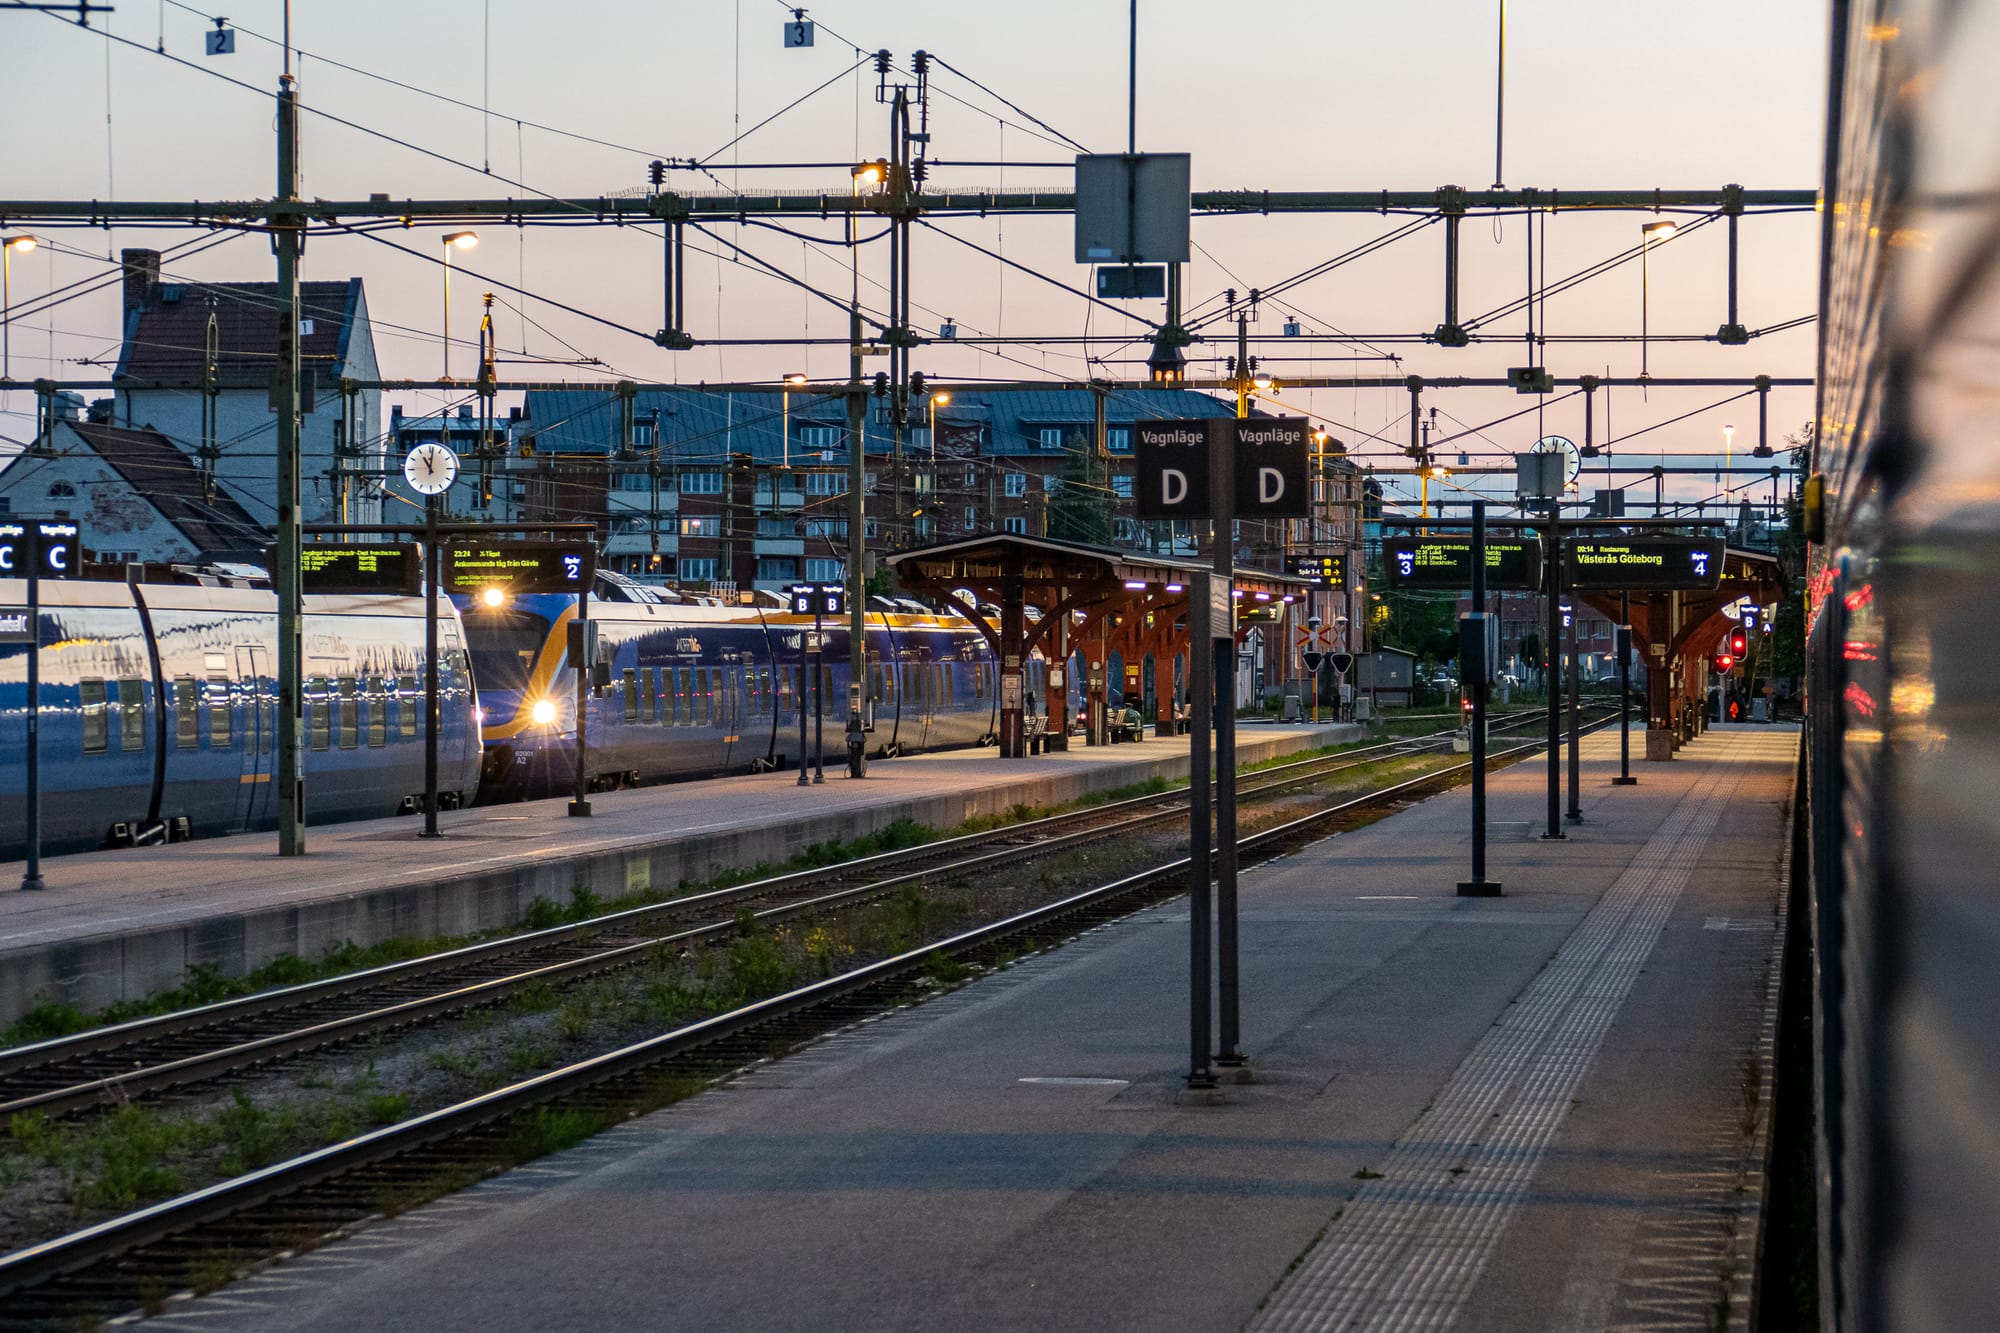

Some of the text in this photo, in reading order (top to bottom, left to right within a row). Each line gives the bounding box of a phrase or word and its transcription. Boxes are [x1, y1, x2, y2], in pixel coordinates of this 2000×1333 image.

[794, 25, 805, 45] 3
[215, 32, 226, 53] 2
[302, 322, 307, 334] 1
[944, 326, 952, 338] 2
[1289, 325, 1296, 337] 3
[1142, 431, 1204, 447] Vagnläge
[1239, 429, 1301, 445] Vagnläge
[1162, 469, 1188, 505] D
[1259, 467, 1285, 503] D
[0, 546, 13, 569] C
[49, 546, 66, 569] C
[1577, 553, 1663, 566] Västerås Göteborg
[567, 565, 578, 578] 2
[1400, 561, 1411, 575] 3
[1695, 561, 1706, 575] 4
[798, 599, 807, 611] B
[828, 599, 837, 611] B
[1745, 616, 1753, 627] B
[1763, 623, 1771, 631] A
